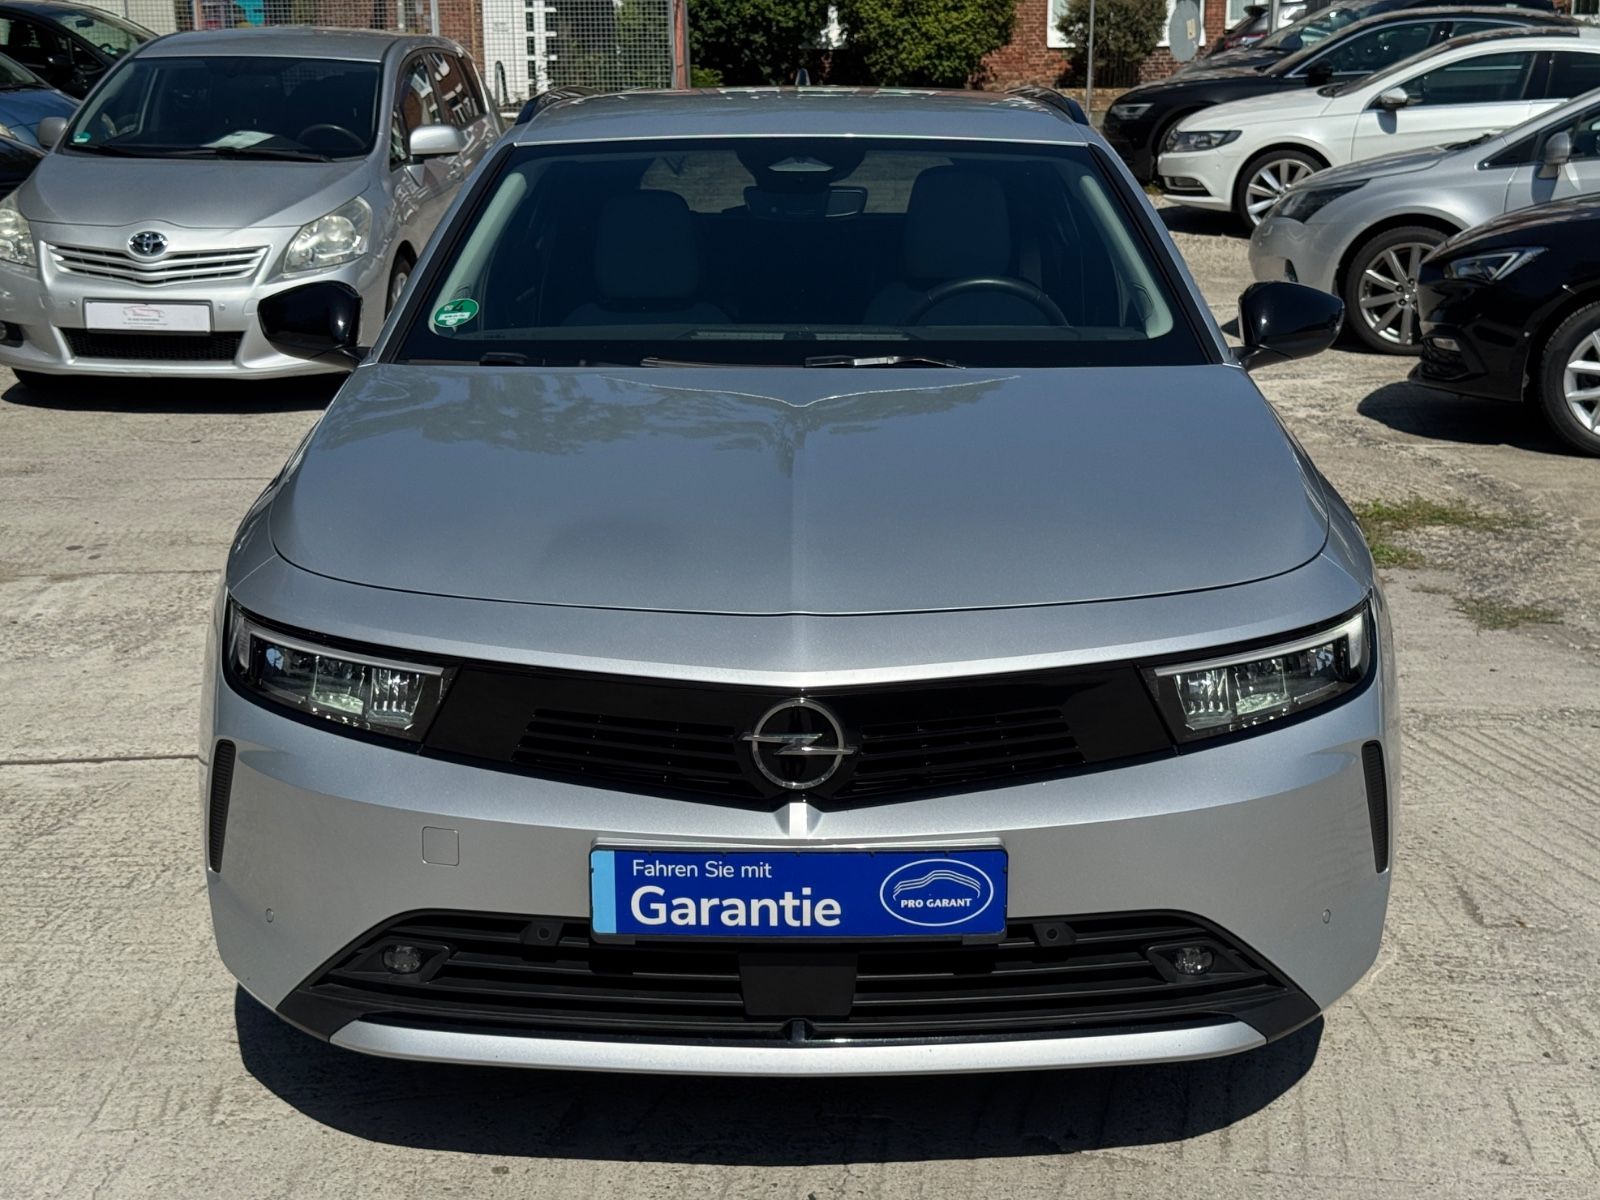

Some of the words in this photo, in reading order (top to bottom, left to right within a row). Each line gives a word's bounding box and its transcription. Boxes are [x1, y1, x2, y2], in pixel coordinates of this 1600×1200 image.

[632, 859, 699, 877] Fahren
[705, 860, 735, 878] Sie
[741, 861, 772, 879] mit
[630, 885, 842, 927] Garantie
[900, 899, 924, 908] PRO
[926, 898, 973, 908] GARANT
